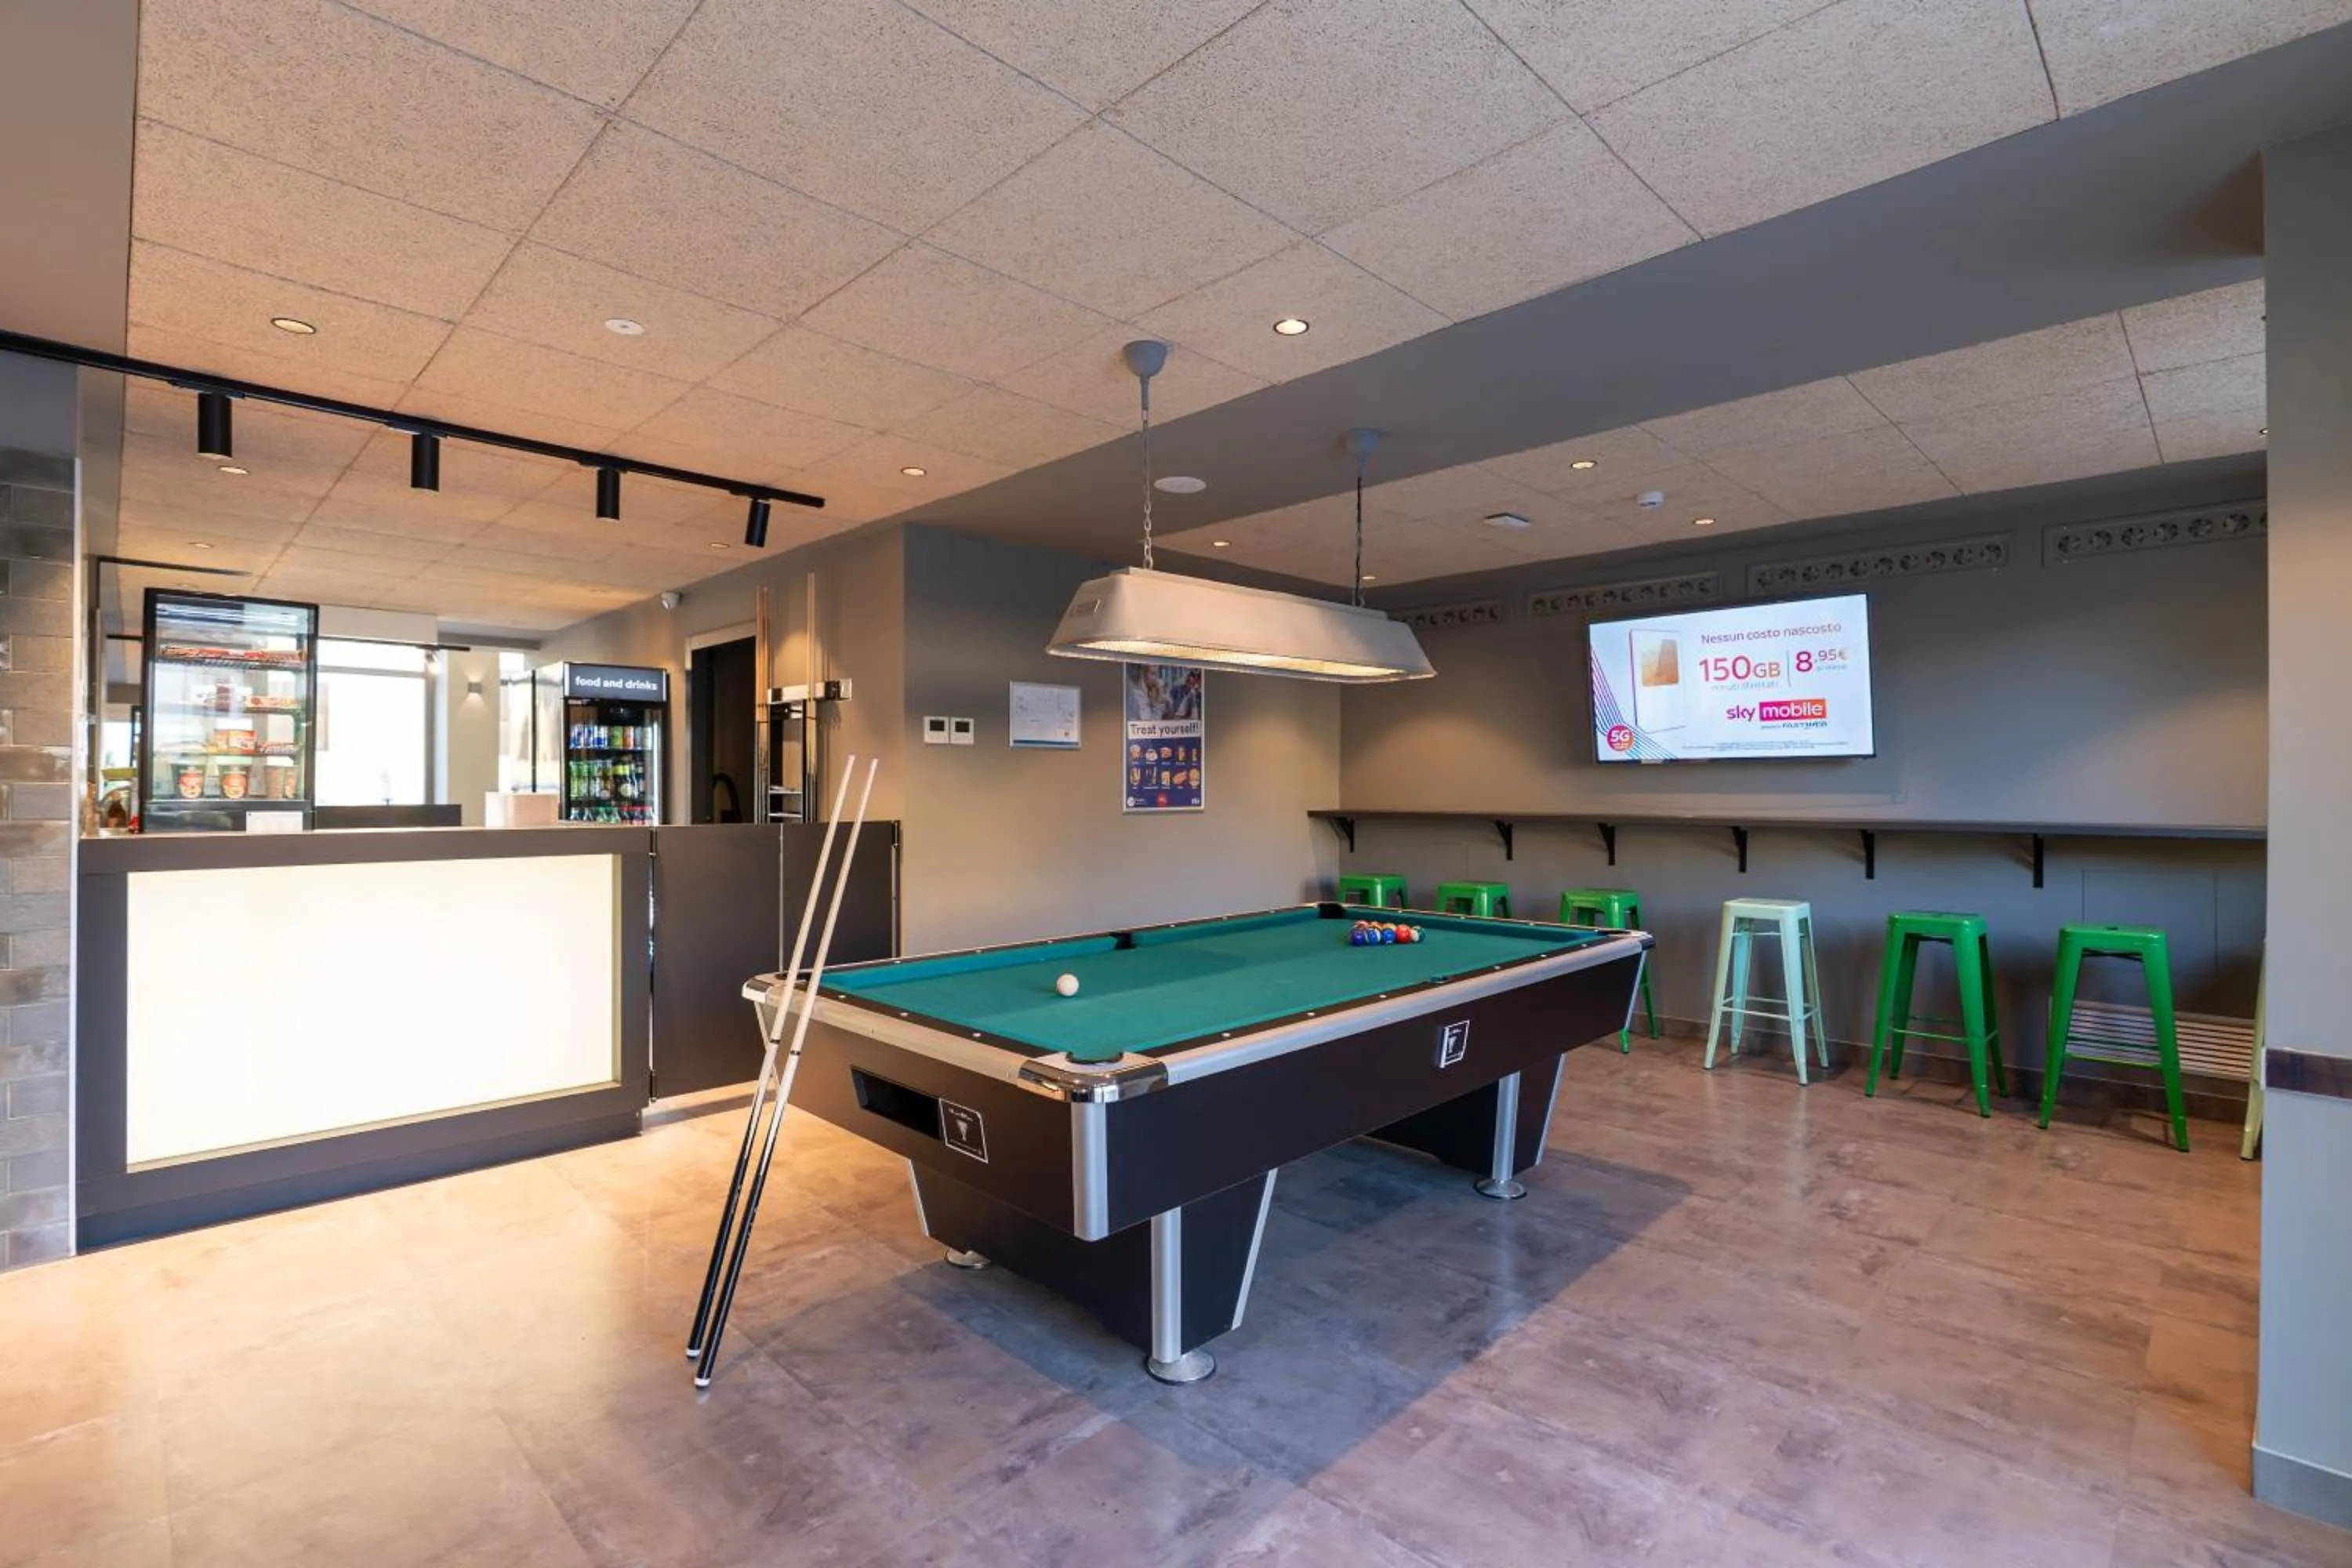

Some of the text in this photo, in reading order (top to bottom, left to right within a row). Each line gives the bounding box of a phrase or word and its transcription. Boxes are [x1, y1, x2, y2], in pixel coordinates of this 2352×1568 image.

[1701, 622, 1842, 644] Nessun costo nascosto
[1699, 655, 1780, 682] 150GB
[575, 676, 658, 691] food and drinks
[1726, 702, 1823, 721] sky mobile
[1130, 724, 1156, 735] Treat
[1611, 730, 1630, 742] 5G
